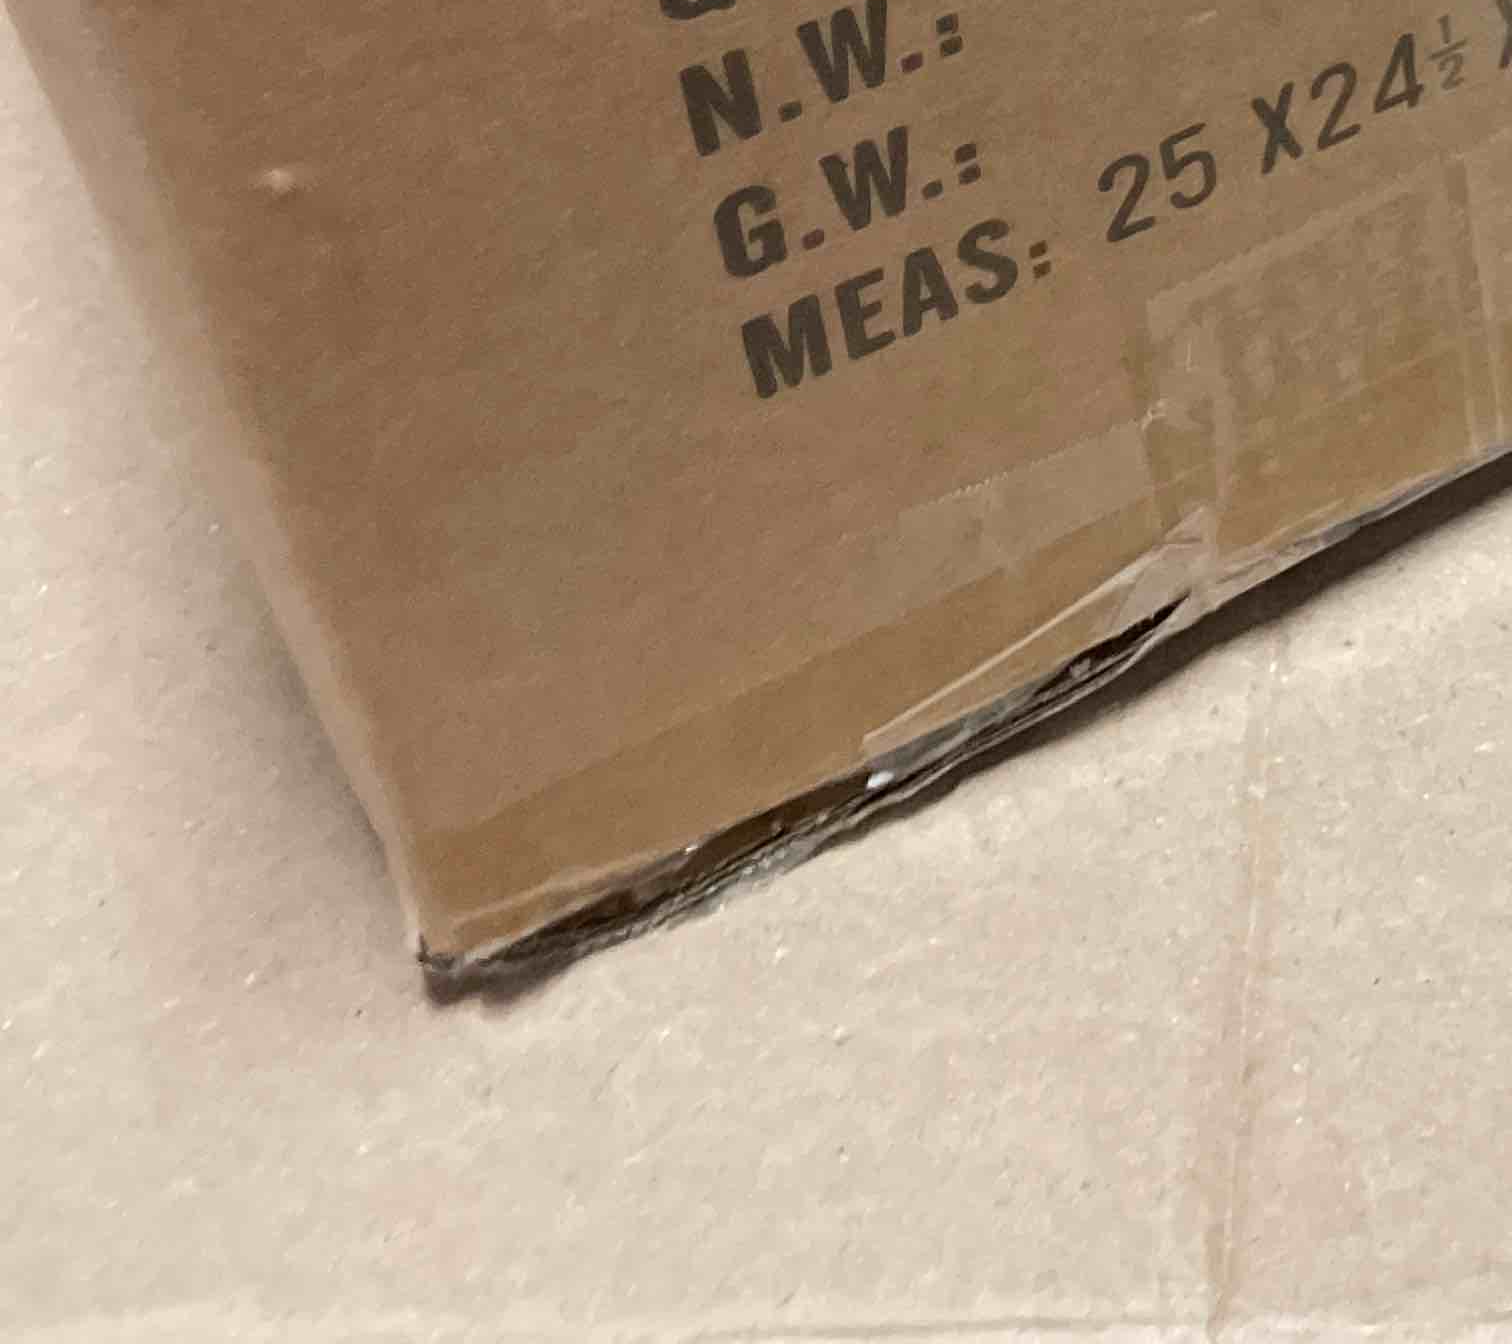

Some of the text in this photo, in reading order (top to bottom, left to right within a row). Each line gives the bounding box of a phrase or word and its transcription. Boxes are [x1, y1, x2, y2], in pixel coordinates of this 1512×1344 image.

[712, 126, 982, 277] G.W.:
[741, 218, 1052, 398] MEAS:
[1096, 122, 1217, 243] 25
